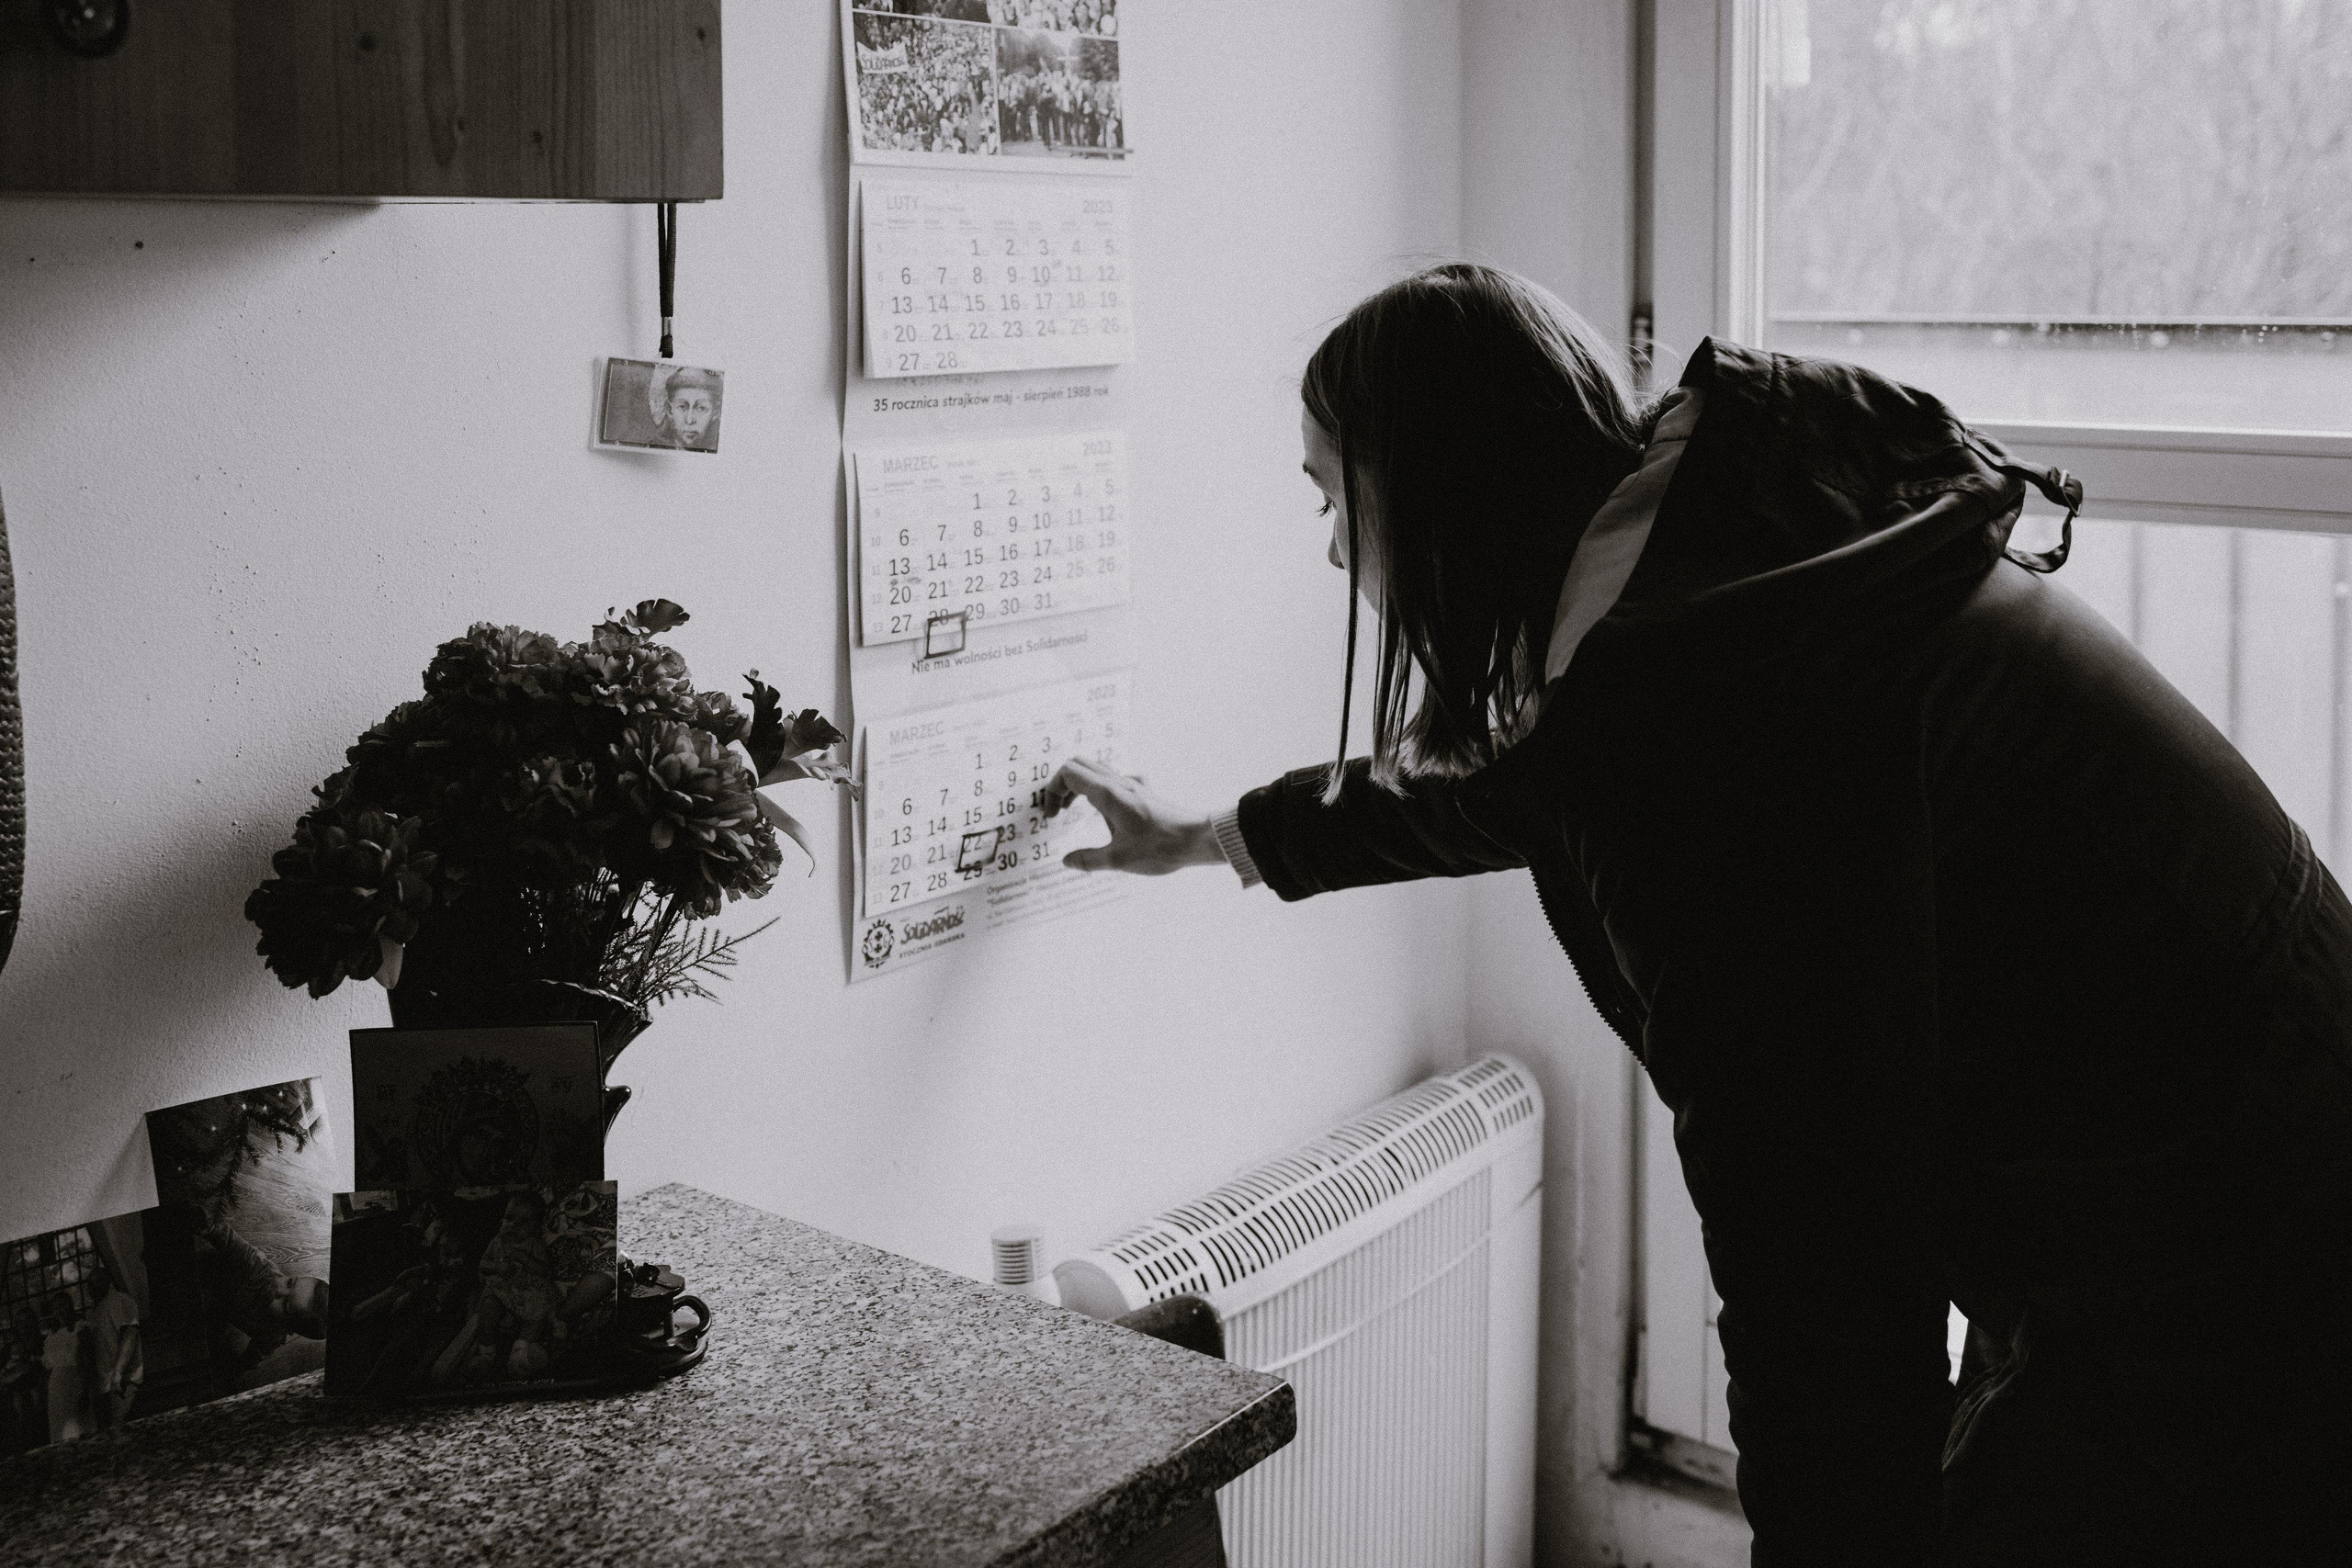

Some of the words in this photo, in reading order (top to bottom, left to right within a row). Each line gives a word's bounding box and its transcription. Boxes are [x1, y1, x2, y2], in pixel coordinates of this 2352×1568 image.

[886, 195, 919, 211] LUTY
[971, 239, 981, 256] 1
[1005, 239, 1015, 256] 2
[1039, 239, 1049, 256] 3
[1072, 240, 1081, 255] 4
[1104, 239, 1114, 256] 5
[901, 266, 912, 286] 6
[937, 266, 947, 285] 7
[972, 266, 983, 285] 8
[1007, 265, 1017, 284] 9
[1033, 265, 1051, 285] 10
[1067, 265, 1083, 283] 11
[1098, 265, 1116, 283] 12
[891, 295, 913, 314] 13
[928, 294, 950, 313] 14
[964, 294, 987, 312] 15
[1001, 293, 1021, 311] 16
[1035, 292, 1053, 310] 17
[1068, 292, 1086, 310] 18
[1100, 290, 1117, 309] 19
[894, 324, 917, 343] 20
[932, 323, 954, 342] 21
[967, 321, 989, 340] 22
[1002, 320, 1023, 339] 23
[1036, 319, 1057, 337] 24
[1102, 316, 1120, 334] 26
[899, 352, 921, 372] 27
[936, 350, 958, 369] 28
[873, 397, 888, 412] 35
[891, 394, 940, 411] rocznica
[943, 391, 989, 410] strajków
[993, 389, 1012, 405] maj
[883, 455, 939, 474] MARZEC
[973, 492, 982, 510] 1
[1008, 488, 1018, 506] 2
[1042, 485, 1051, 502] 3
[1073, 481, 1082, 497] 4
[1105, 478, 1114, 496] 5
[899, 528, 910, 547] 6
[937, 524, 947, 542] 7
[973, 519, 983, 537] 8
[1008, 515, 1018, 534] 9
[1034, 512, 1052, 530] 10
[1067, 508, 1083, 526] 11
[1098, 504, 1115, 523] 12
[888, 557, 911, 577] 13
[926, 552, 948, 571] 14
[965, 547, 984, 567] 15
[1000, 543, 1019, 561] 16
[1035, 538, 1053, 557] 17
[1068, 535, 1085, 552] 18
[1098, 530, 1115, 548] 19
[889, 585, 912, 605] 20
[928, 581, 948, 600] 21
[965, 575, 985, 594] 22
[999, 570, 1020, 589] 23
[1034, 565, 1052, 584] 24
[1067, 559, 1085, 579] 25
[1098, 556, 1116, 575] 26
[890, 613, 912, 634] 27
[966, 603, 986, 622] 29
[1000, 597, 1021, 616] 30
[1034, 592, 1053, 610] 31
[911, 660, 930, 674] Nie
[933, 659, 951, 671] ma
[888, 720, 944, 746] MARZEC
[975, 752, 984, 770] 1
[1009, 744, 1019, 762] 2
[1042, 736, 1052, 754] 3
[1105, 722, 1114, 739] 5
[901, 797, 912, 816] 6
[940, 787, 949, 806] 7
[974, 779, 983, 797] 8
[1008, 770, 1018, 788] 9
[1031, 761, 1050, 783] 10
[891, 826, 912, 847] 13
[928, 816, 947, 837] 14
[964, 806, 983, 827] 15
[998, 797, 1016, 818] 16
[890, 853, 912, 875] 20
[927, 843, 947, 864] 21
[963, 834, 982, 854] 22
[996, 823, 1016, 844] 23
[890, 881, 912, 903] 27
[927, 872, 947, 893] 28
[998, 851, 1017, 871] 30
[1032, 841, 1050, 861] 31
